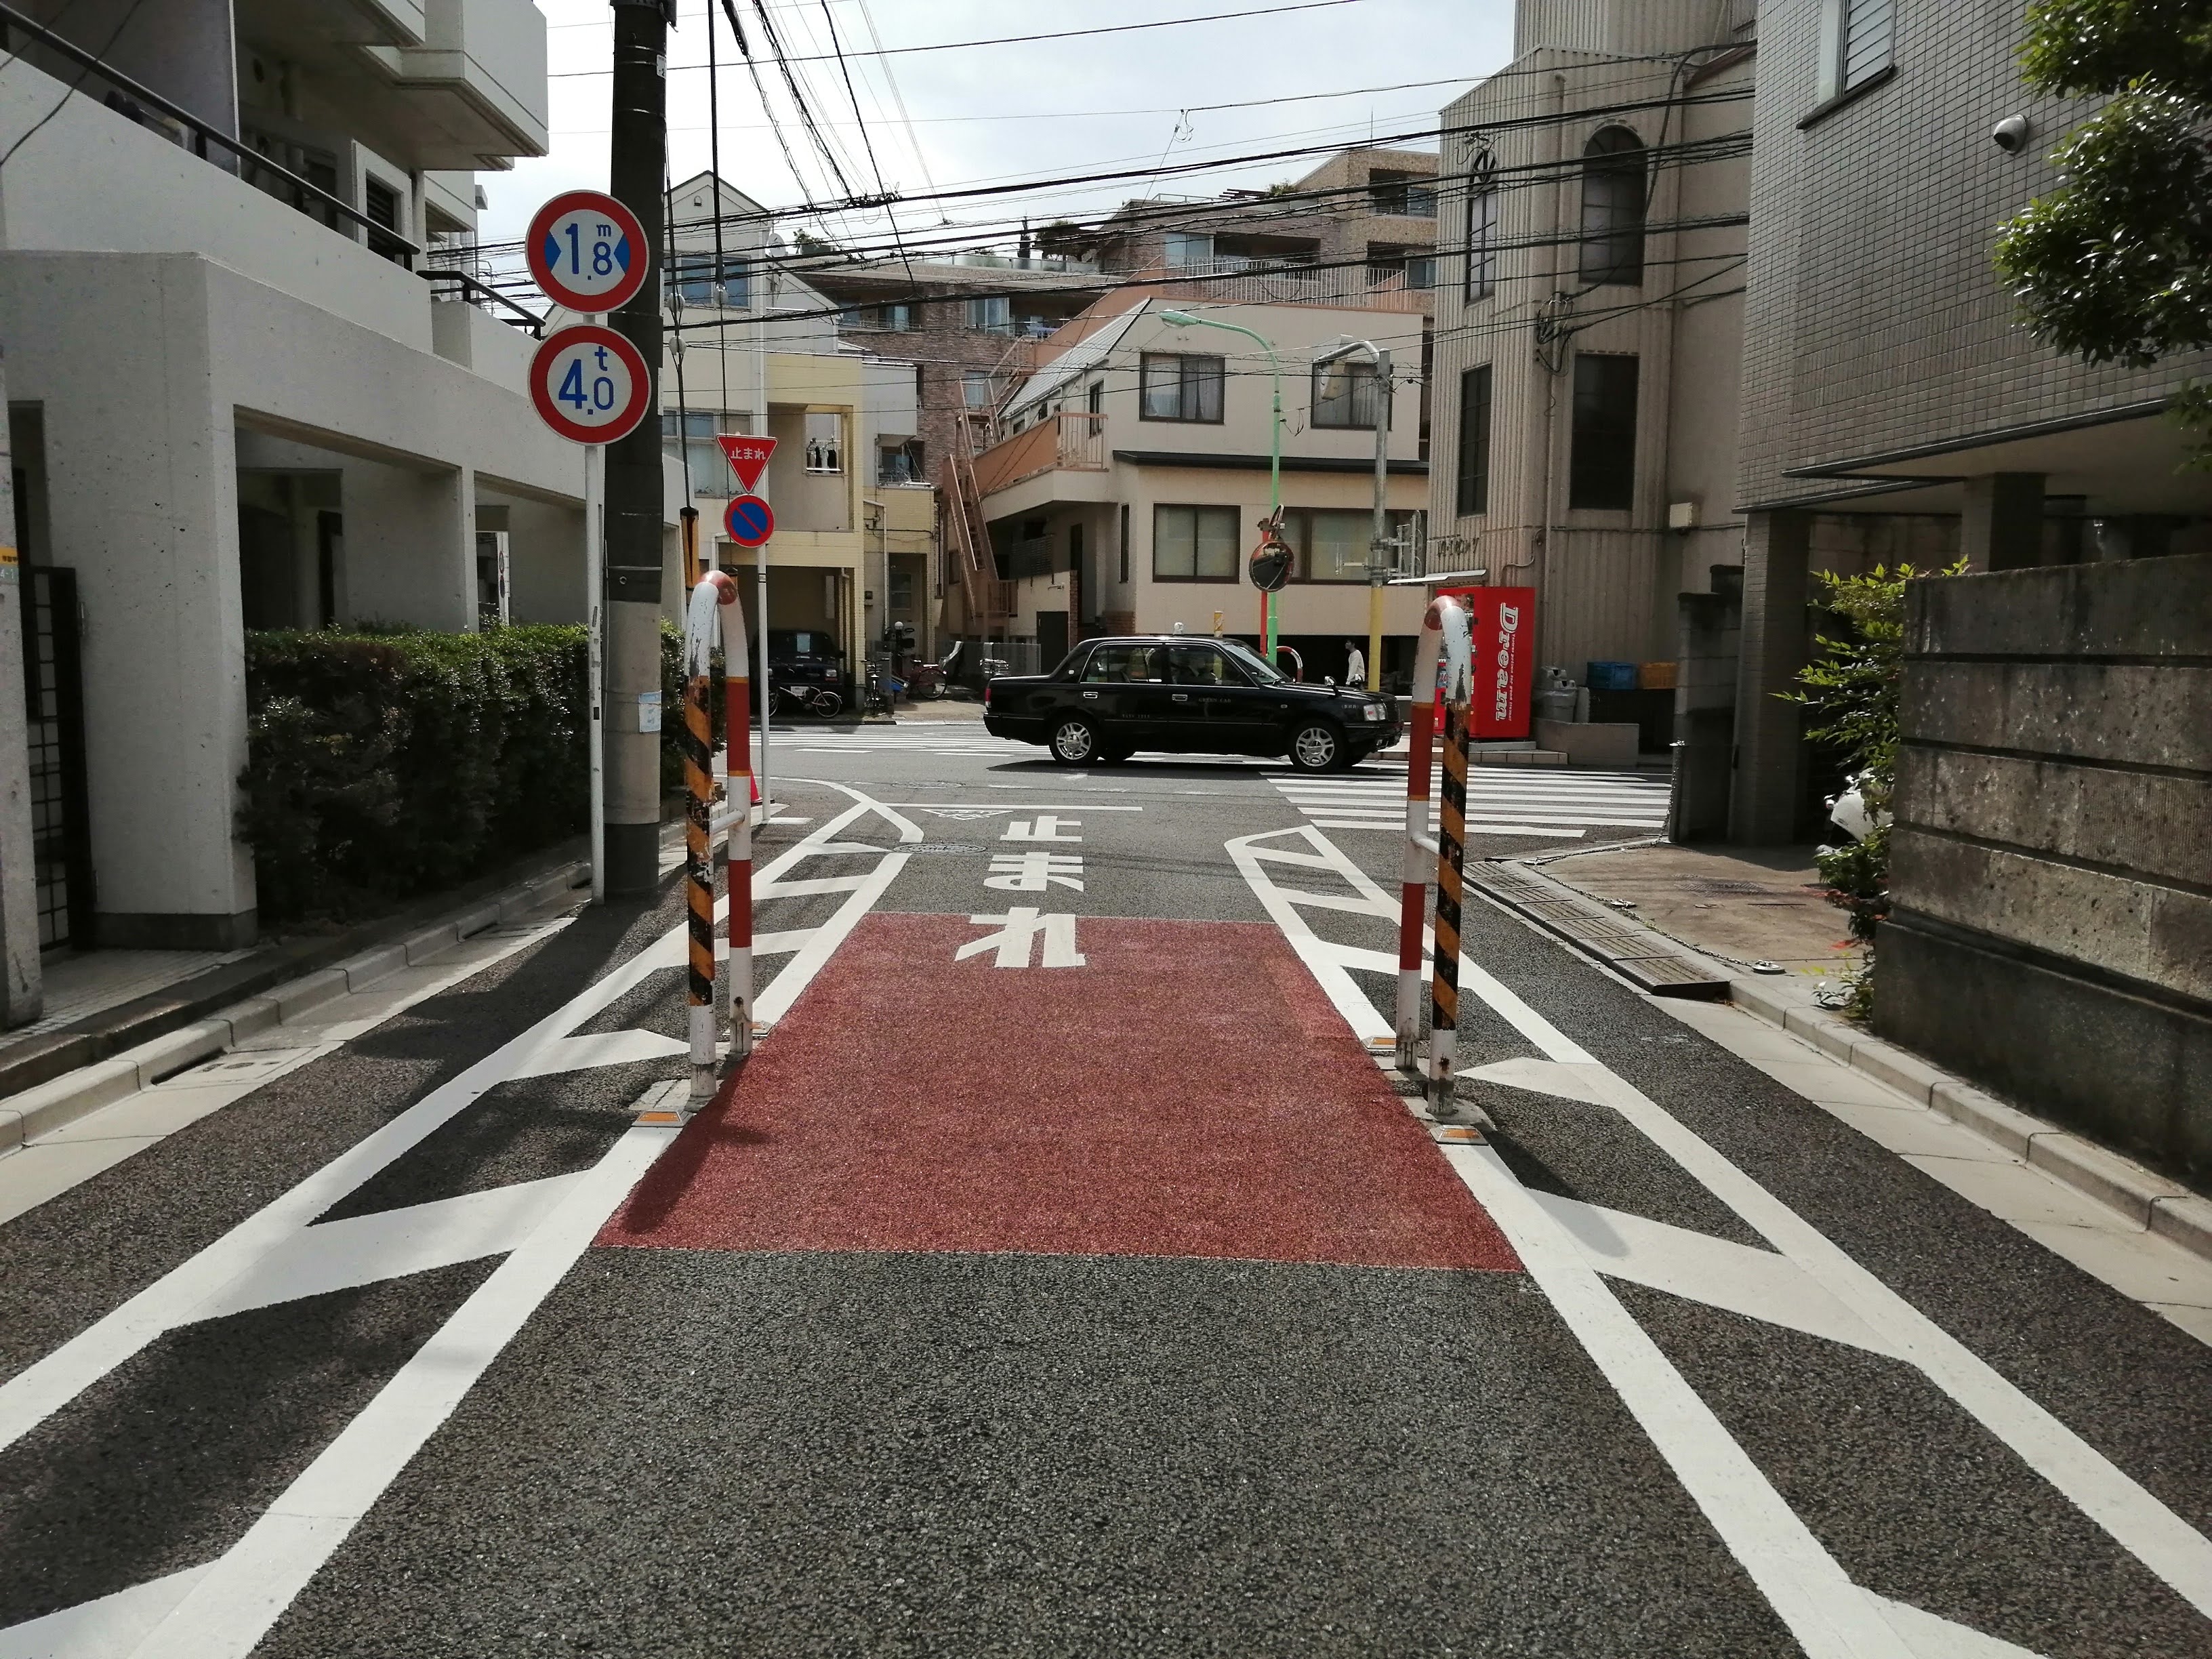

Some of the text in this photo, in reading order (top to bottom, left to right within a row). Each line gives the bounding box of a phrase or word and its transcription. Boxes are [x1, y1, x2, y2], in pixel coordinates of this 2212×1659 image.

[596, 224, 612, 237] m
[594, 346, 608, 371] t
[731, 447, 766, 460] 止まれ
[1496, 602, 1519, 722] Dream
[954, 816, 1086, 968] 止まれ
